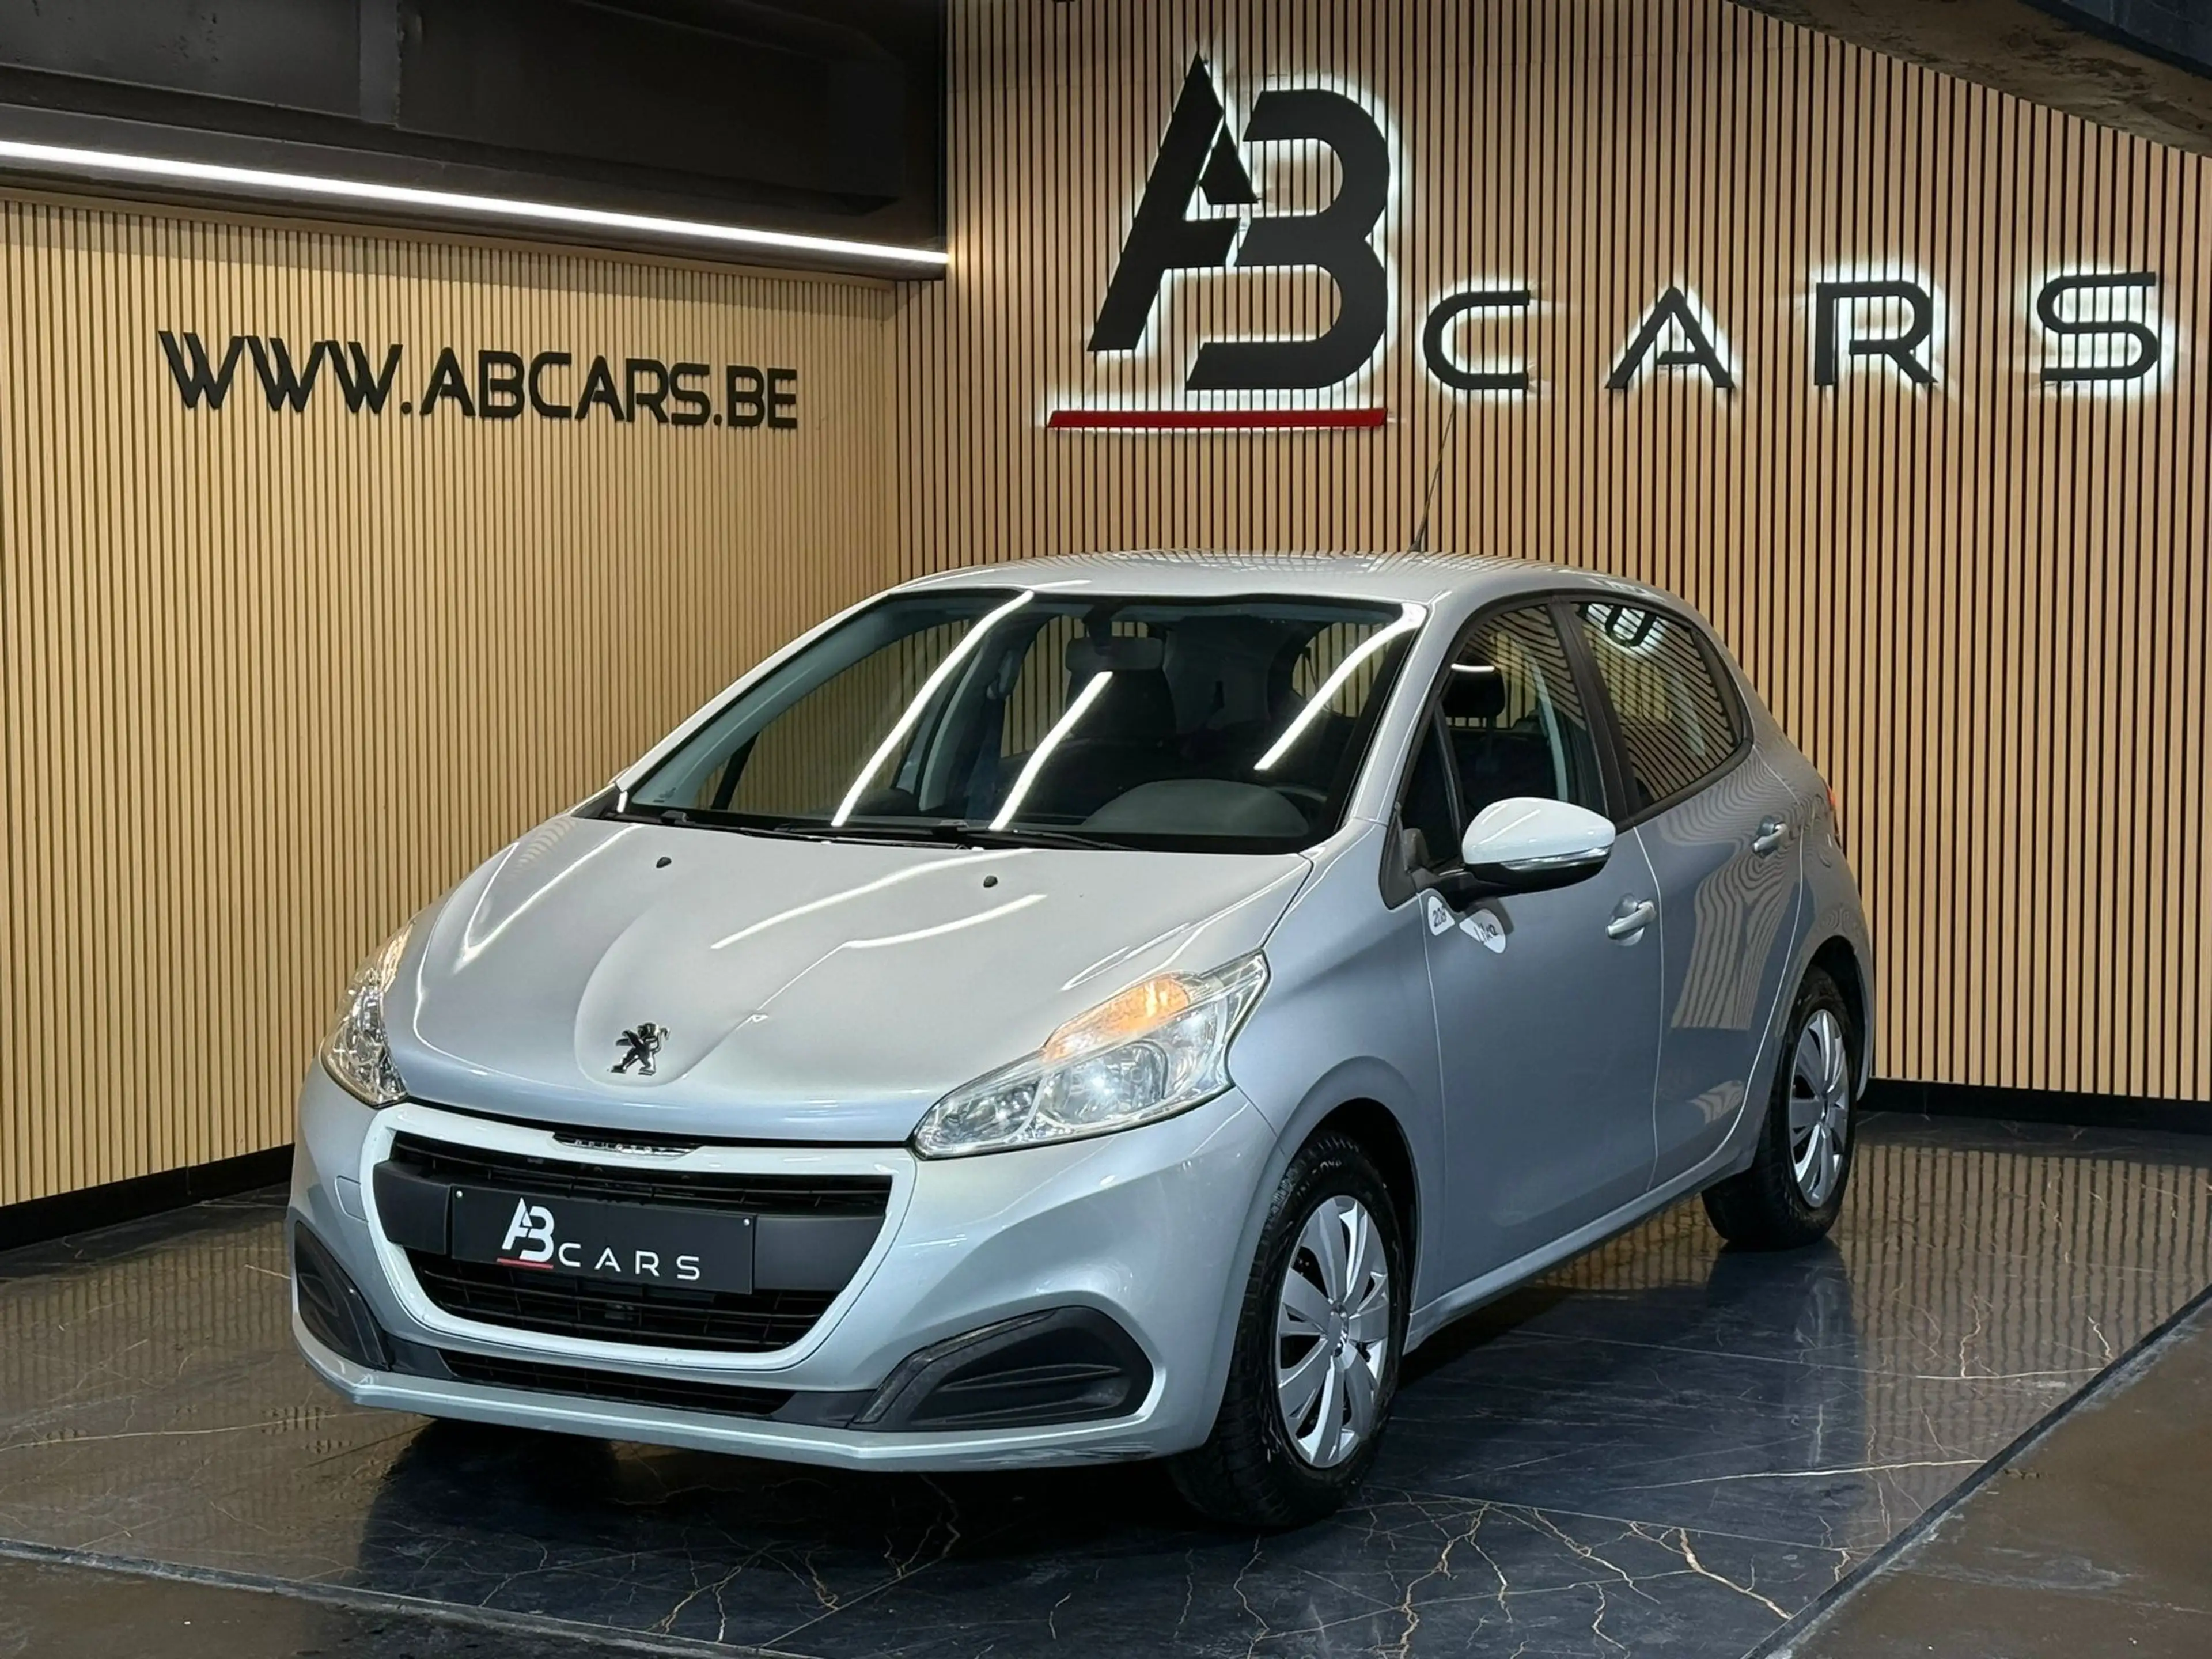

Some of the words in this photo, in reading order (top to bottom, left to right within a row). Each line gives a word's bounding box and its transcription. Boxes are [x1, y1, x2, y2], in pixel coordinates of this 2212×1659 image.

[1087, 53, 1390, 390] AB
[1423, 272, 2159, 391] CARS
[158, 331, 798, 429] WWW.ABCARS.BE
[502, 1197, 555, 1262] AB
[559, 1243, 700, 1281] CARS
